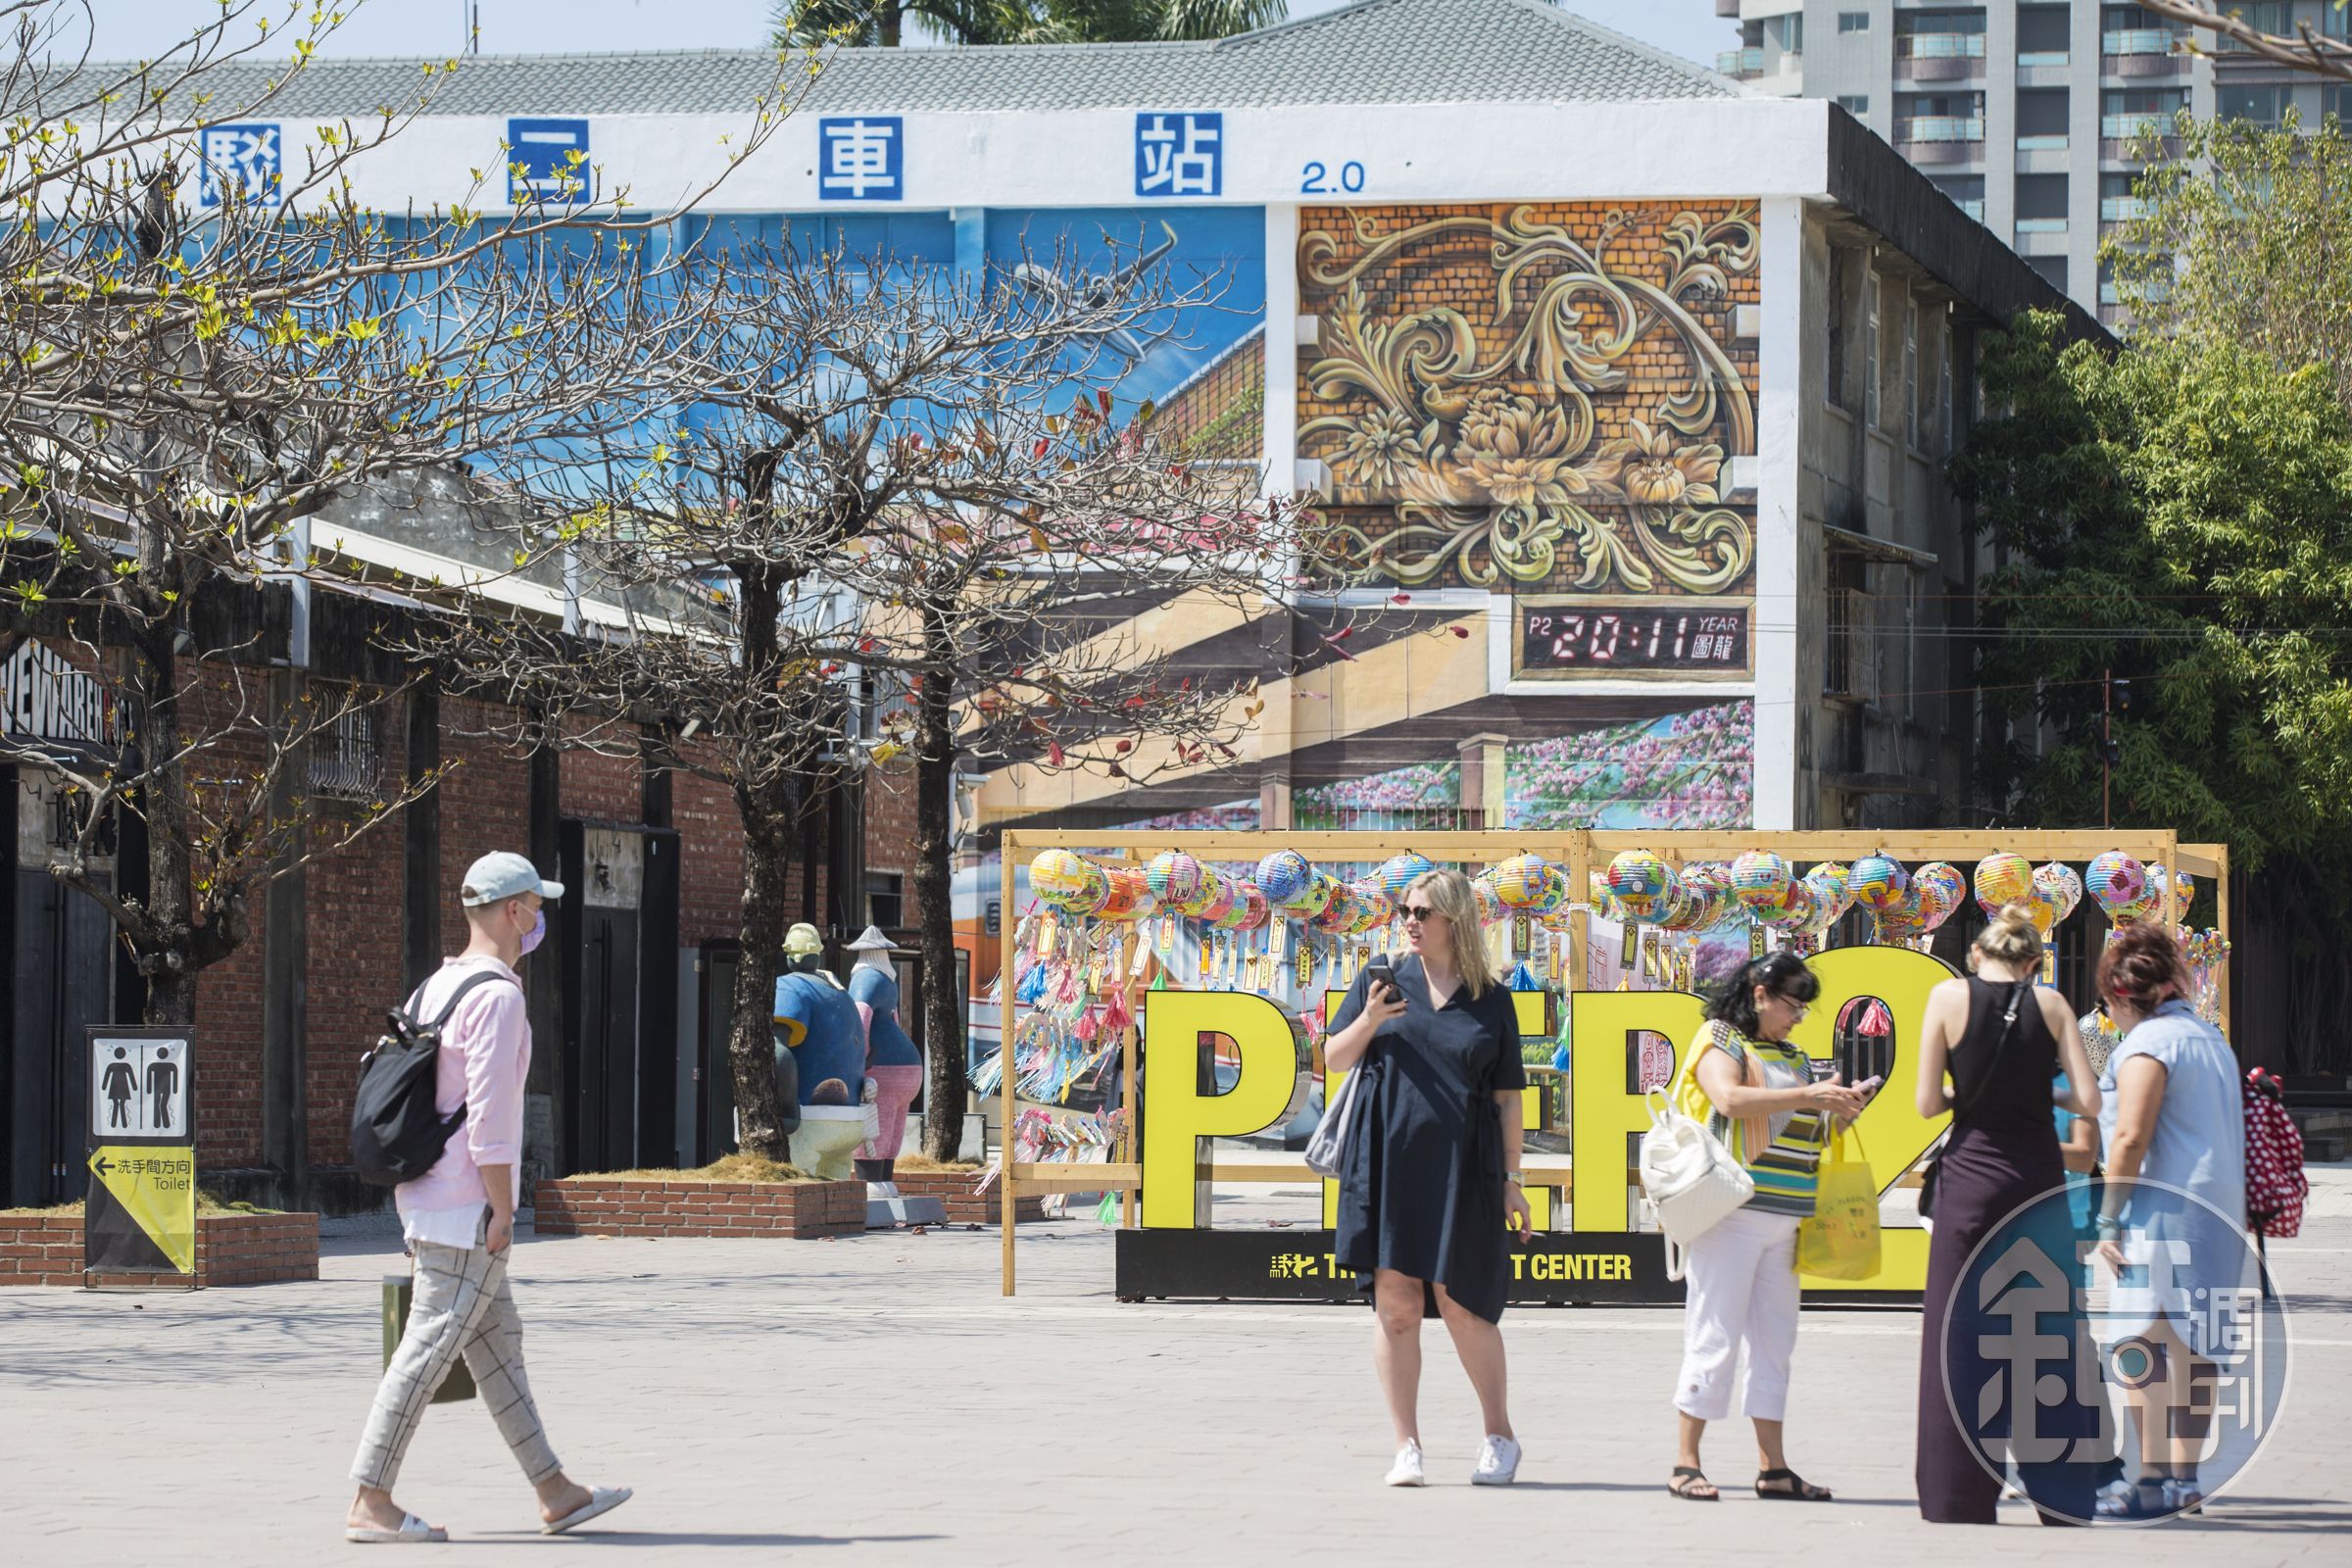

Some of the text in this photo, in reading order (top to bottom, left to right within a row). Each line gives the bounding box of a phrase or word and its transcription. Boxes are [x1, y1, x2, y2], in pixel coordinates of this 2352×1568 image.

[1301, 162, 1365, 193] 2.0
[1529, 615, 1739, 659] P2 20:11 YEAR
[118, 1159, 190, 1174] 洗手間方向
[153, 1177, 190, 1190] Toilet
[1531, 1253, 1632, 1280] CENTER
